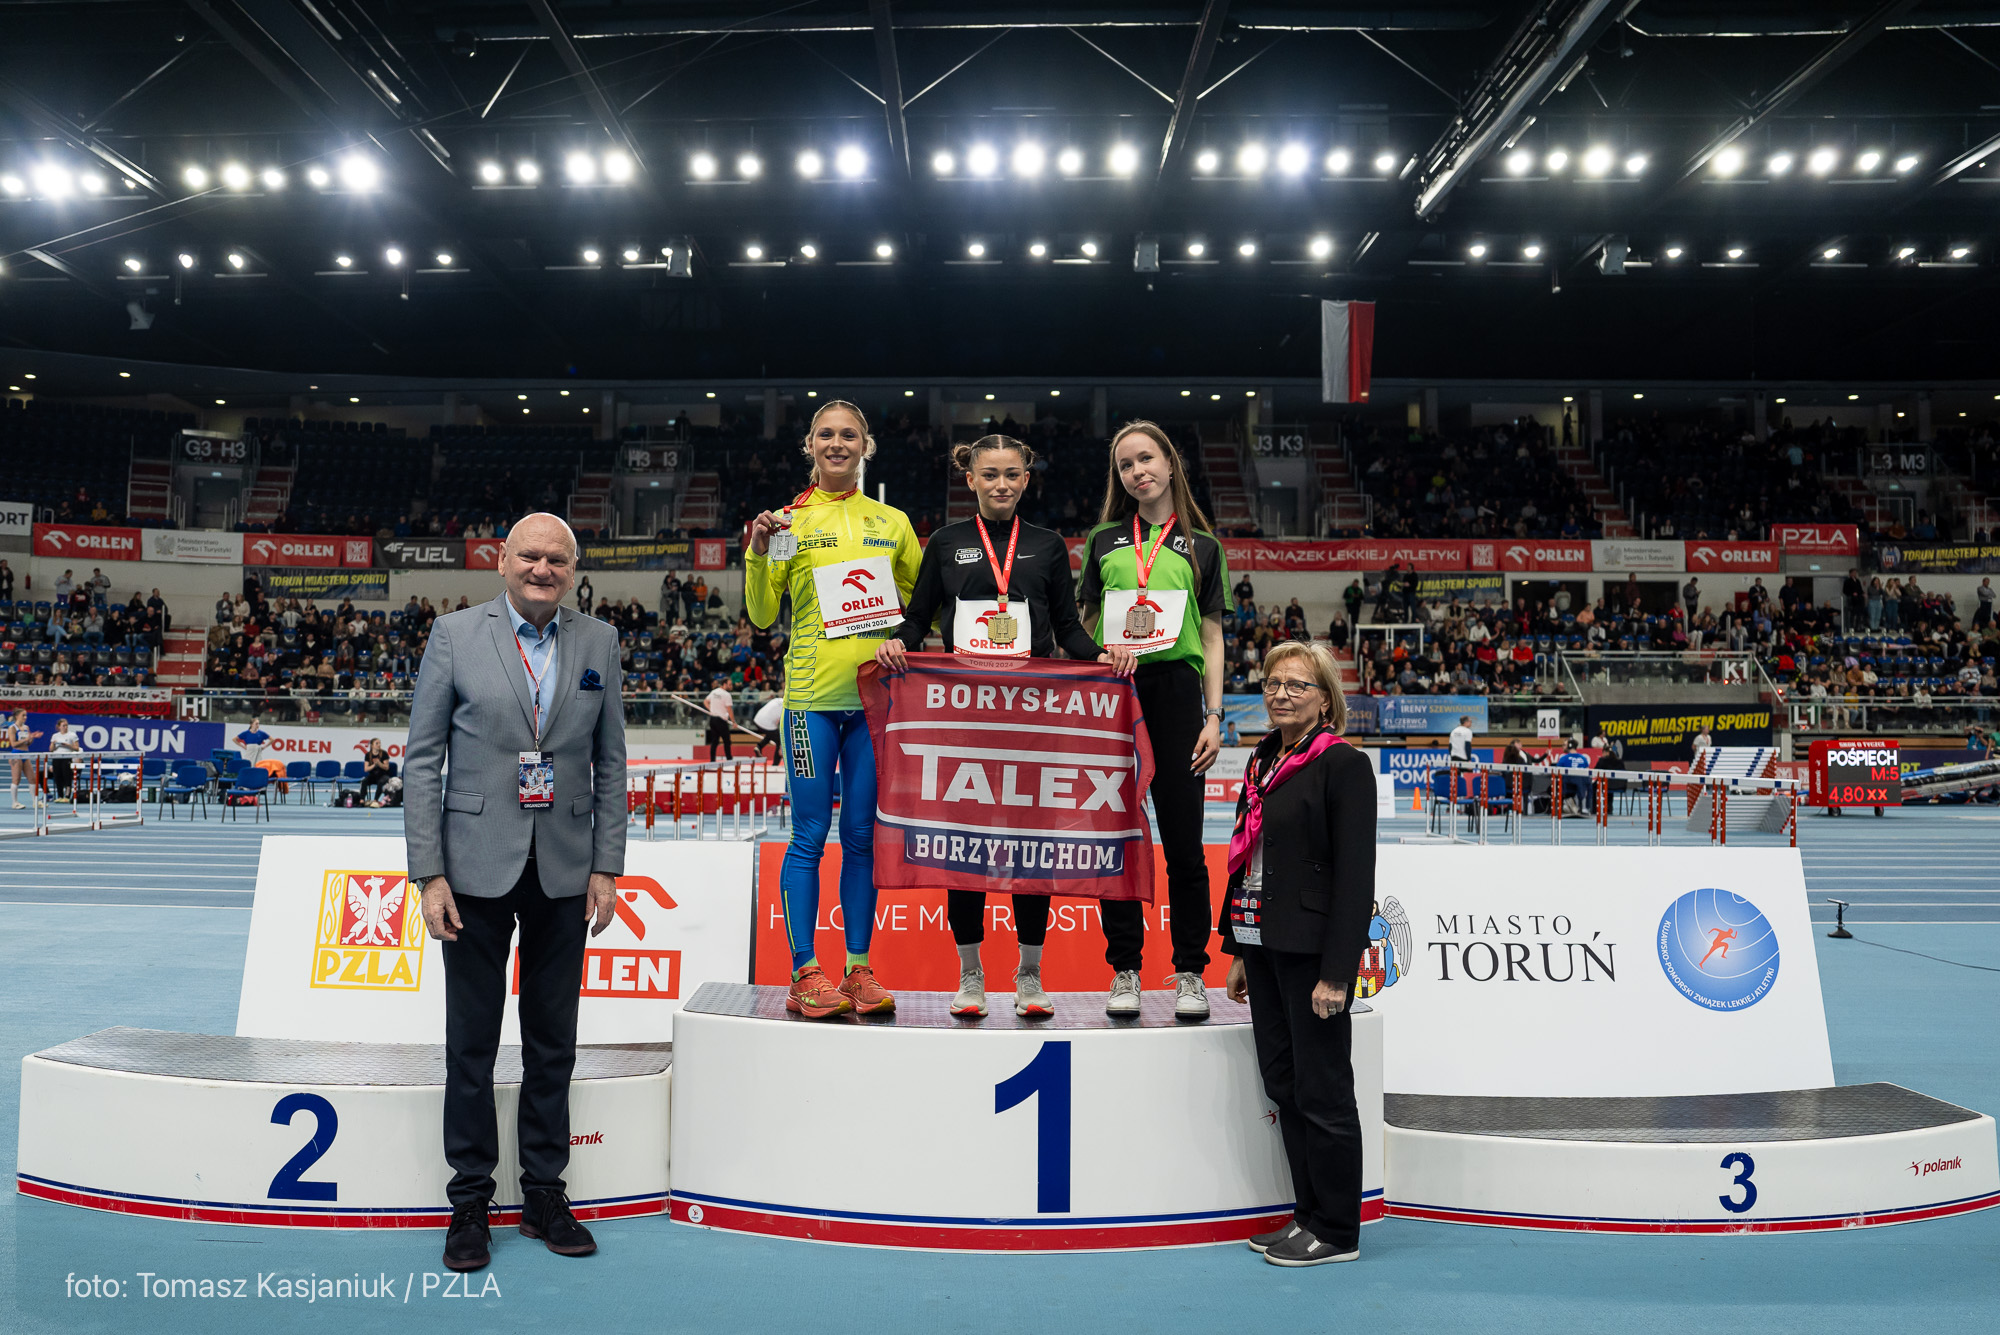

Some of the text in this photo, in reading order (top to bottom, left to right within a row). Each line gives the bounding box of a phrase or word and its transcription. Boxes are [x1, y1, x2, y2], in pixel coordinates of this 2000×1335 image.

[185, 440, 246, 458] G3 H3
[1252, 435, 1303, 451] J3 K3
[1871, 454, 1925, 469] L3 M3
[76, 535, 133, 550] ORLEN
[1782, 528, 1848, 545] PZLA
[281, 543, 334, 557] ORLEN
[384, 542, 404, 553] 4F
[401, 547, 455, 563] FUEL
[616, 545, 655, 557] MIASTEM
[656, 543, 689, 554] SPORTU
[1255, 550, 1325, 562] ZWIĄZEK
[1329, 549, 1388, 560] LEKKIEJ
[1392, 549, 1460, 560] ATLETYKI
[1534, 548, 1584, 561] ORLEN
[1720, 549, 1771, 562] ORLEN
[1936, 547, 1978, 559] MIASTEM
[346, 555, 368, 563] PZLA
[304, 575, 349, 586] MIASTEM
[350, 574, 387, 585] SPORTU
[1422, 579, 1465, 590] MIASTEM
[1466, 577, 1502, 589] SPORTU
[841, 595, 884, 612] ORLEN
[846, 619, 888, 632] TORUŃ 2024
[1724, 660, 1748, 680] K1
[180, 697, 207, 717] H1
[926, 684, 1120, 719] BORYSŁAW
[1401, 704, 1484, 714] IRENY SZEWIŃSKIEJ
[1539, 717, 1556, 729] 40
[1793, 705, 1815, 725] L1
[1599, 712, 1770, 737] TORUŃ MIASTEM SPORTU
[271, 738, 332, 753] ORLEN
[1627, 734, 1682, 746] www.torun.pl
[1827, 748, 1898, 767] POŚPIECH
[899, 743, 1134, 813] TALEX
[1871, 767, 1899, 781] M:5
[1829, 786, 1865, 802] 4.80
[915, 834, 1116, 871] BORZYTUCHOM
[1436, 914, 1572, 936] MIASTO
[1428, 931, 1617, 983] TORUŃ
[1660, 920, 1775, 1008] KUJAWSKO-POMORSKI ZWIĄZEK LEKKIEJ ATLETYKI
[316, 950, 414, 985] PZLA
[995, 1041, 1071, 1213] 1
[267, 1093, 339, 1201] 2
[1923, 1156, 1962, 1176] polanik
[1718, 1152, 1757, 1213] 3
